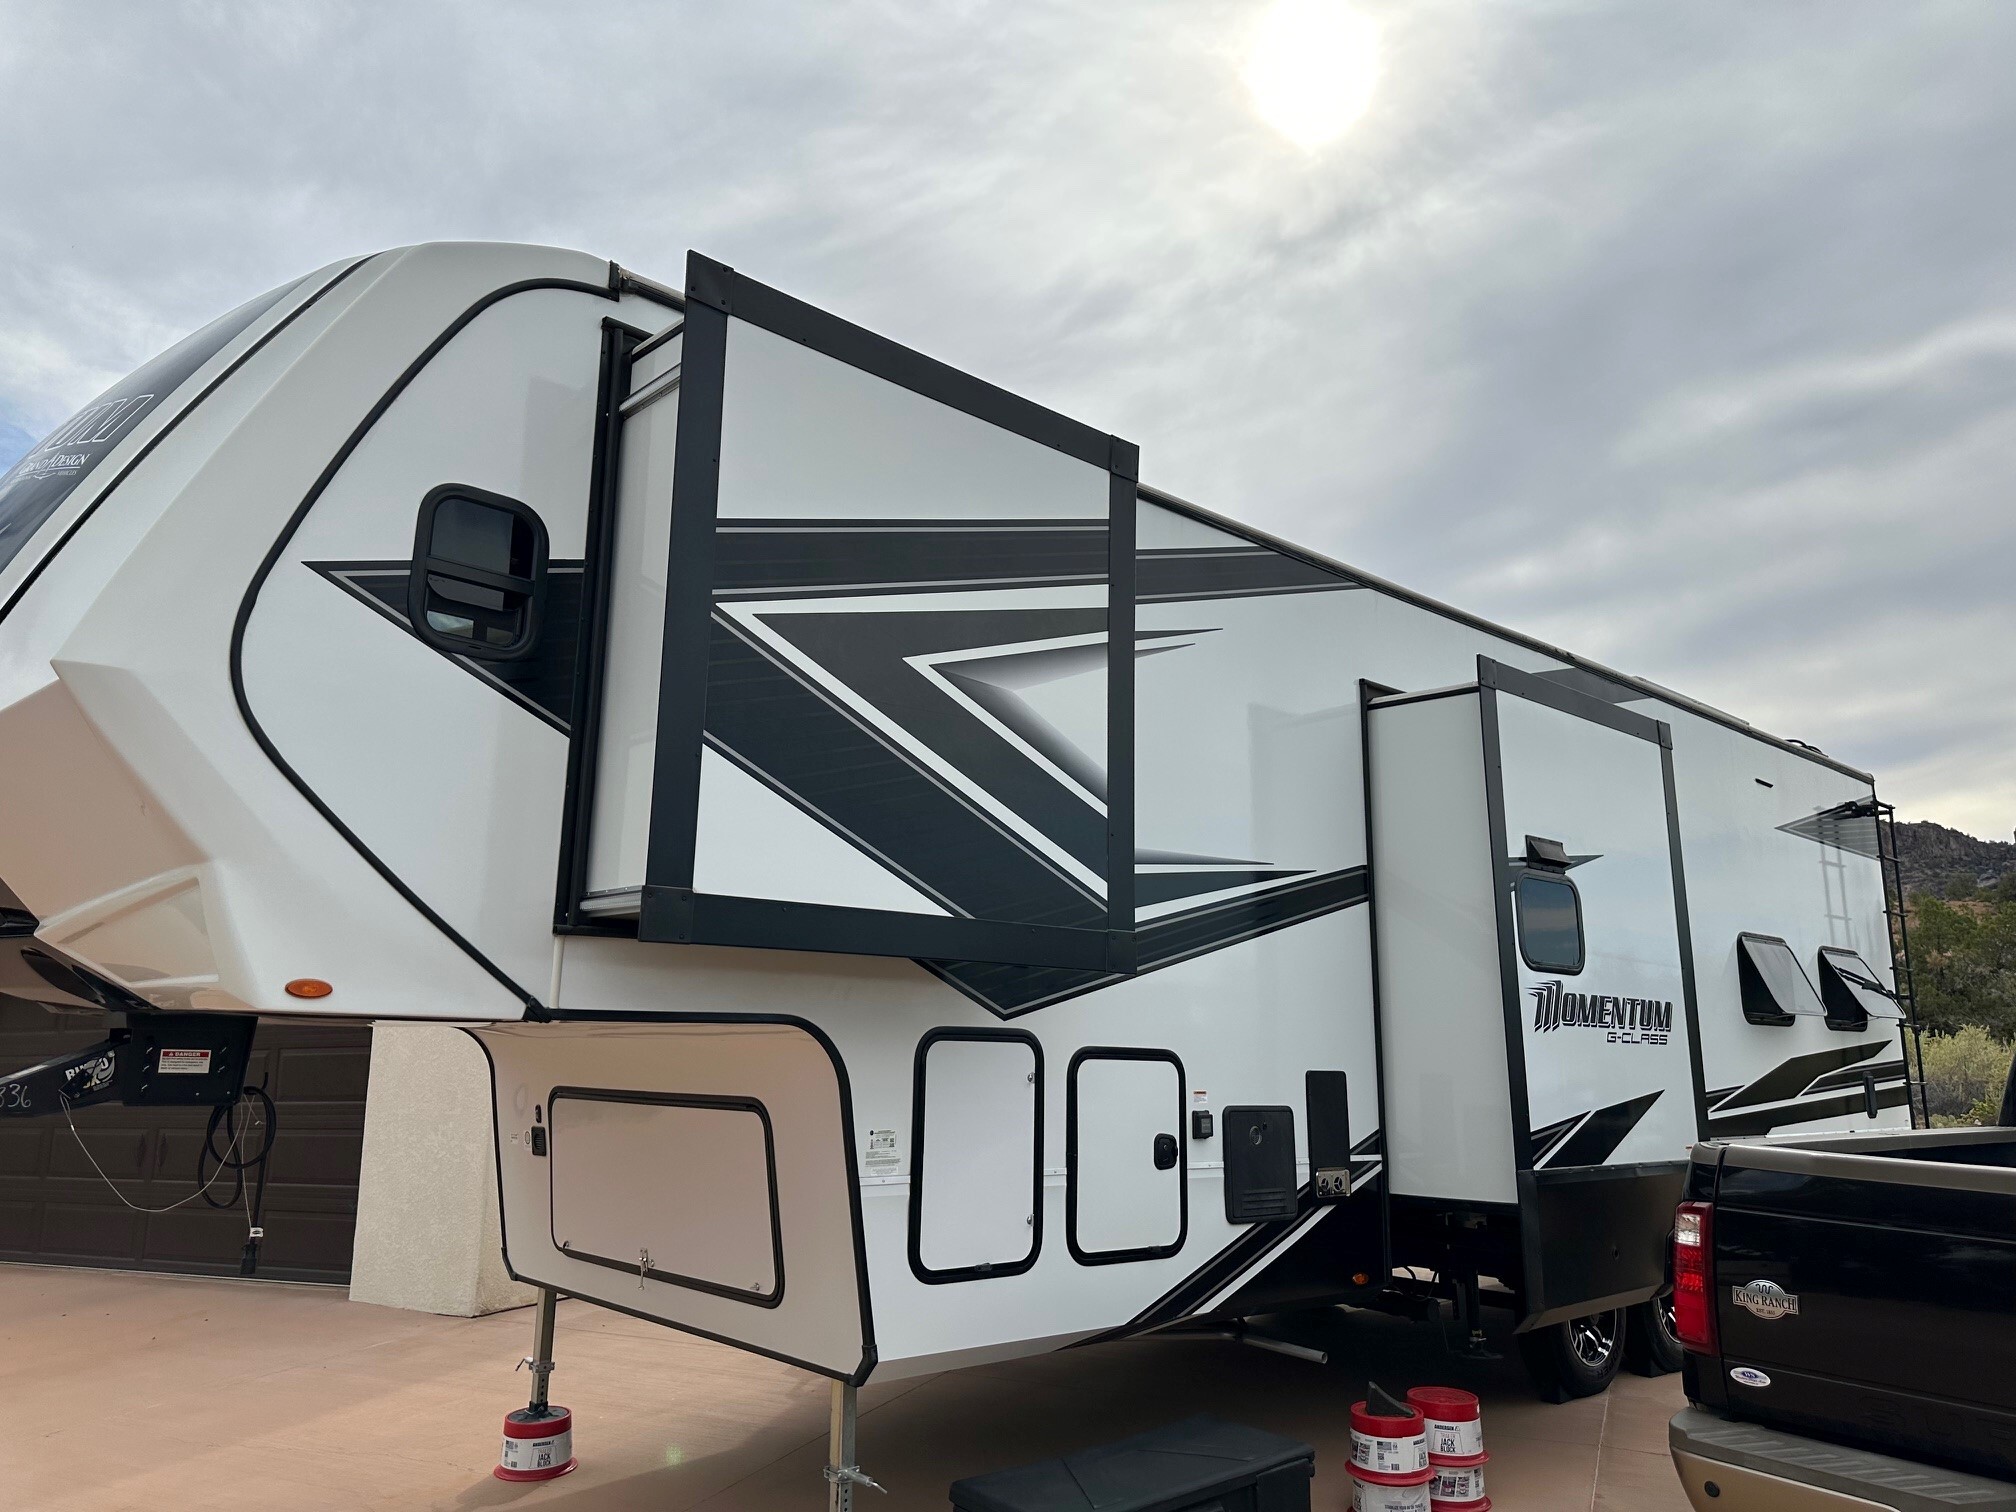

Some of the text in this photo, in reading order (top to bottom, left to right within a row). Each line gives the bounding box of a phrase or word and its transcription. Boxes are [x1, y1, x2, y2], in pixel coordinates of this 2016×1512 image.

[1525, 980, 1673, 1033] MOMENTUM
[1606, 1031, 1668, 1045] G-CLASS
[1735, 1289, 1796, 1311] KING RANCH
[1440, 1443, 1456, 1453] BLOCK
[1441, 1438, 1455, 1446] JACK
[537, 1459, 551, 1468] BLOCK
